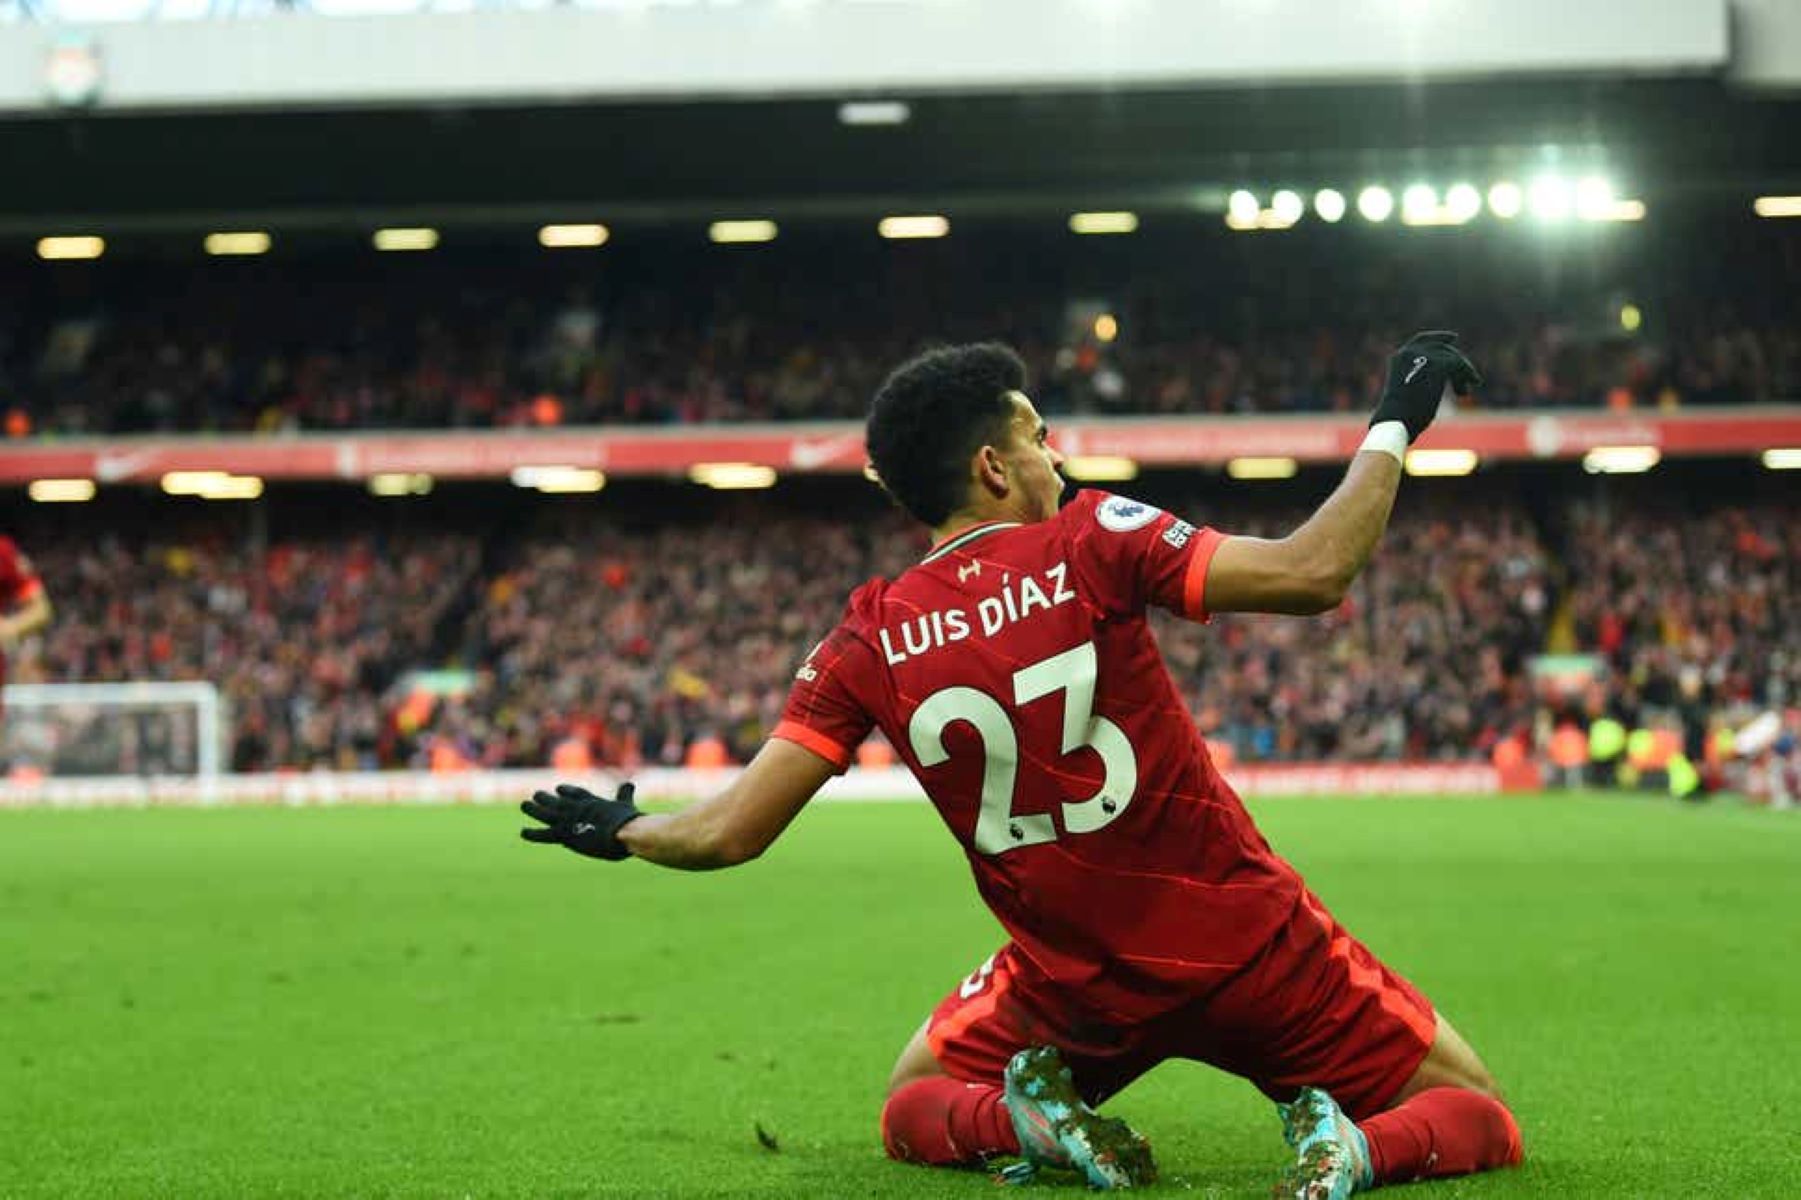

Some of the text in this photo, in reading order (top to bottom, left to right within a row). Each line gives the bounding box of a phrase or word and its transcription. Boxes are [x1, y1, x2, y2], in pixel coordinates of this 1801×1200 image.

[879, 609, 970, 667] LUIS
[978, 561, 1076, 637] DÍAZ
[909, 641, 1138, 855] 23
